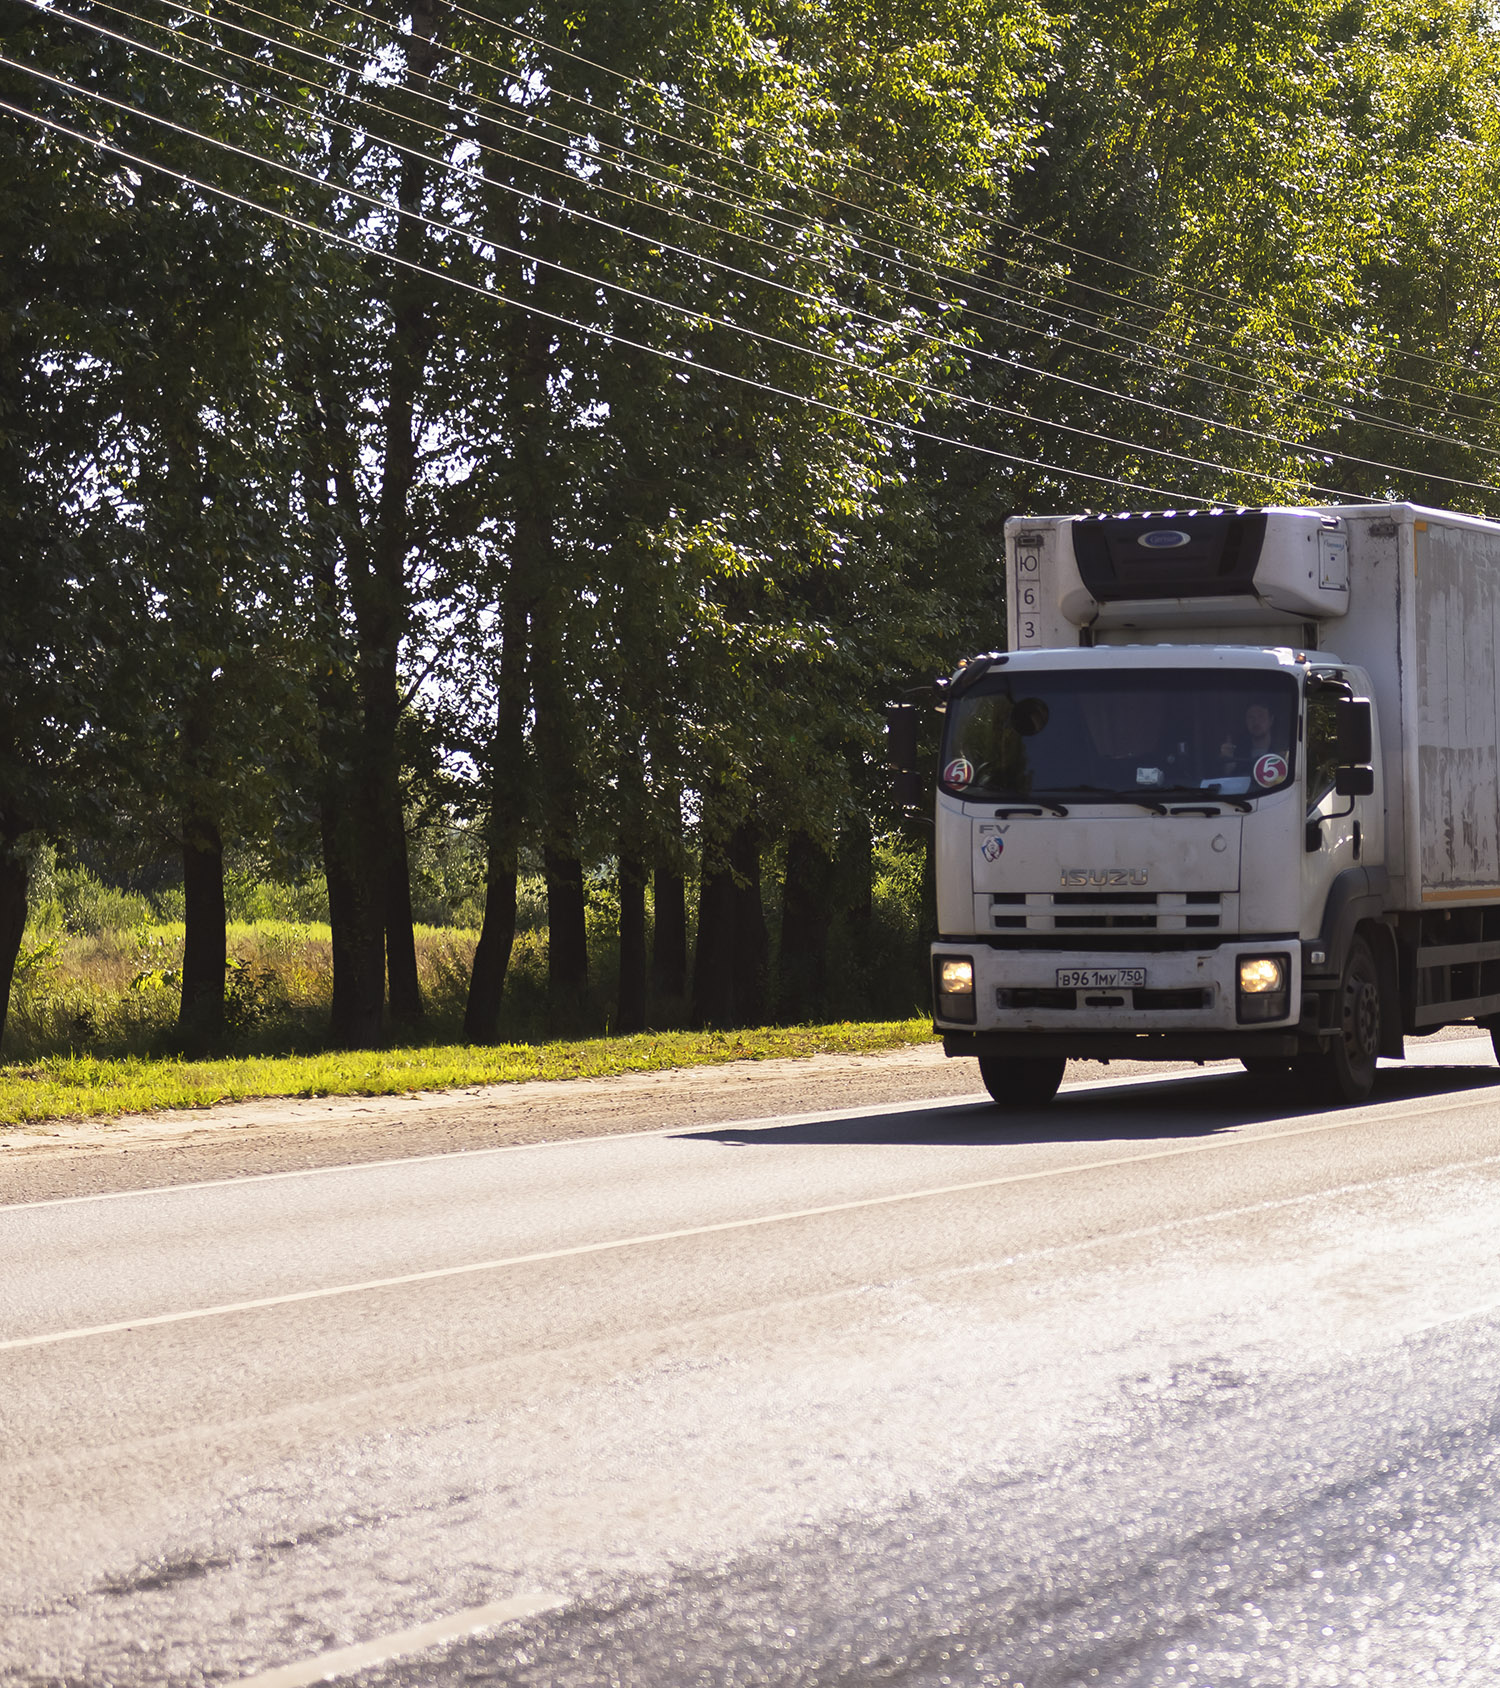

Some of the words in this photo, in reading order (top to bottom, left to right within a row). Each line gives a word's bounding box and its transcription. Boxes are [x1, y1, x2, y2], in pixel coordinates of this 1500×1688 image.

[979, 824, 1011, 834] FV
[1060, 868, 1149, 887] ISUZU
[1119, 970, 1142, 981] 750
